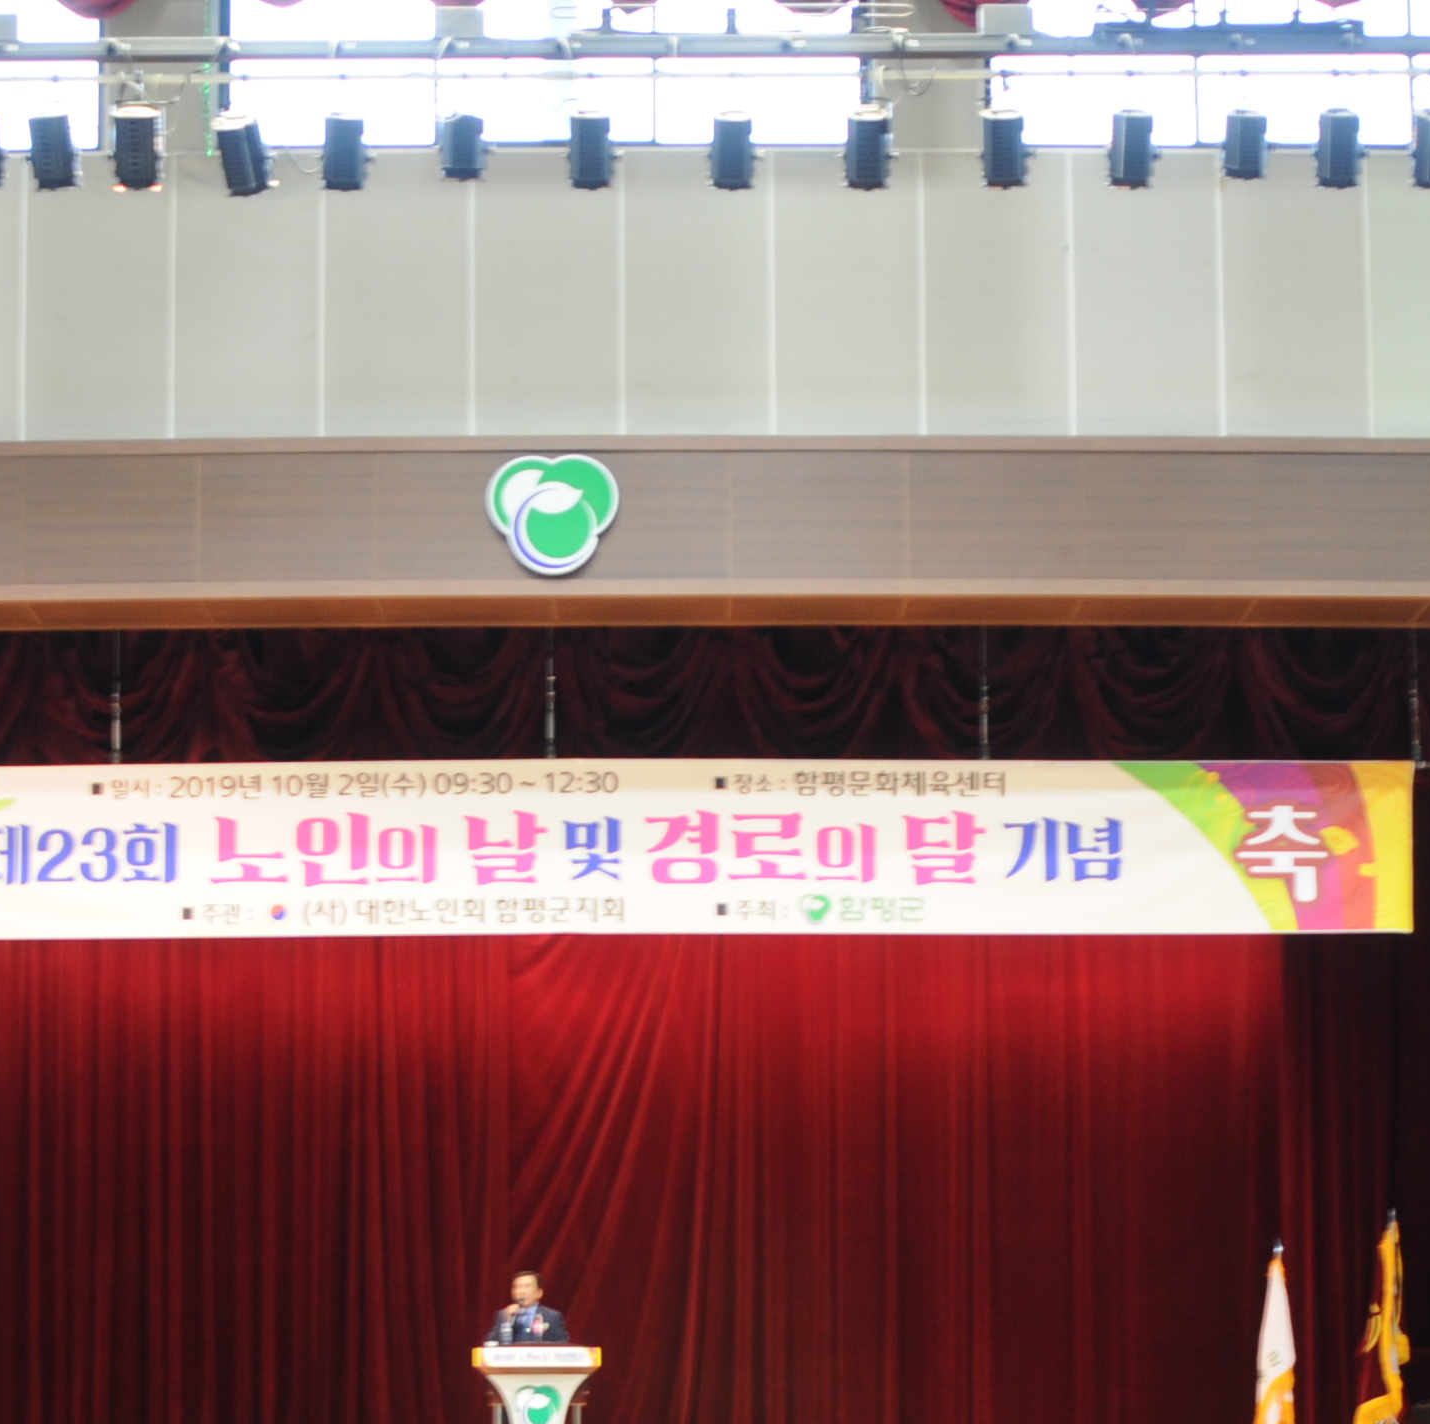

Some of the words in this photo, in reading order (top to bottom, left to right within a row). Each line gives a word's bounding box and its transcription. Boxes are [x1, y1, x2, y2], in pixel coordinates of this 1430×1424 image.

[170, 774, 262, 799] 2019년
[272, 773, 329, 798] 10월
[433, 772, 513, 795] 09:30
[545, 770, 619, 794] 12:30
[794, 770, 1006, 797] 함평문화체육센터
[209, 812, 438, 887] 노인의
[464, 810, 549, 886] 날
[563, 816, 621, 880] 및
[644, 809, 877, 884] 경로의
[902, 810, 987, 886] 달
[1003, 817, 1123, 882] 기념
[1236, 804, 1329, 903] 축
[356, 897, 486, 924] 대한노인회
[495, 897, 626, 924] 함평군지회
[838, 896, 925, 922] 함평군
